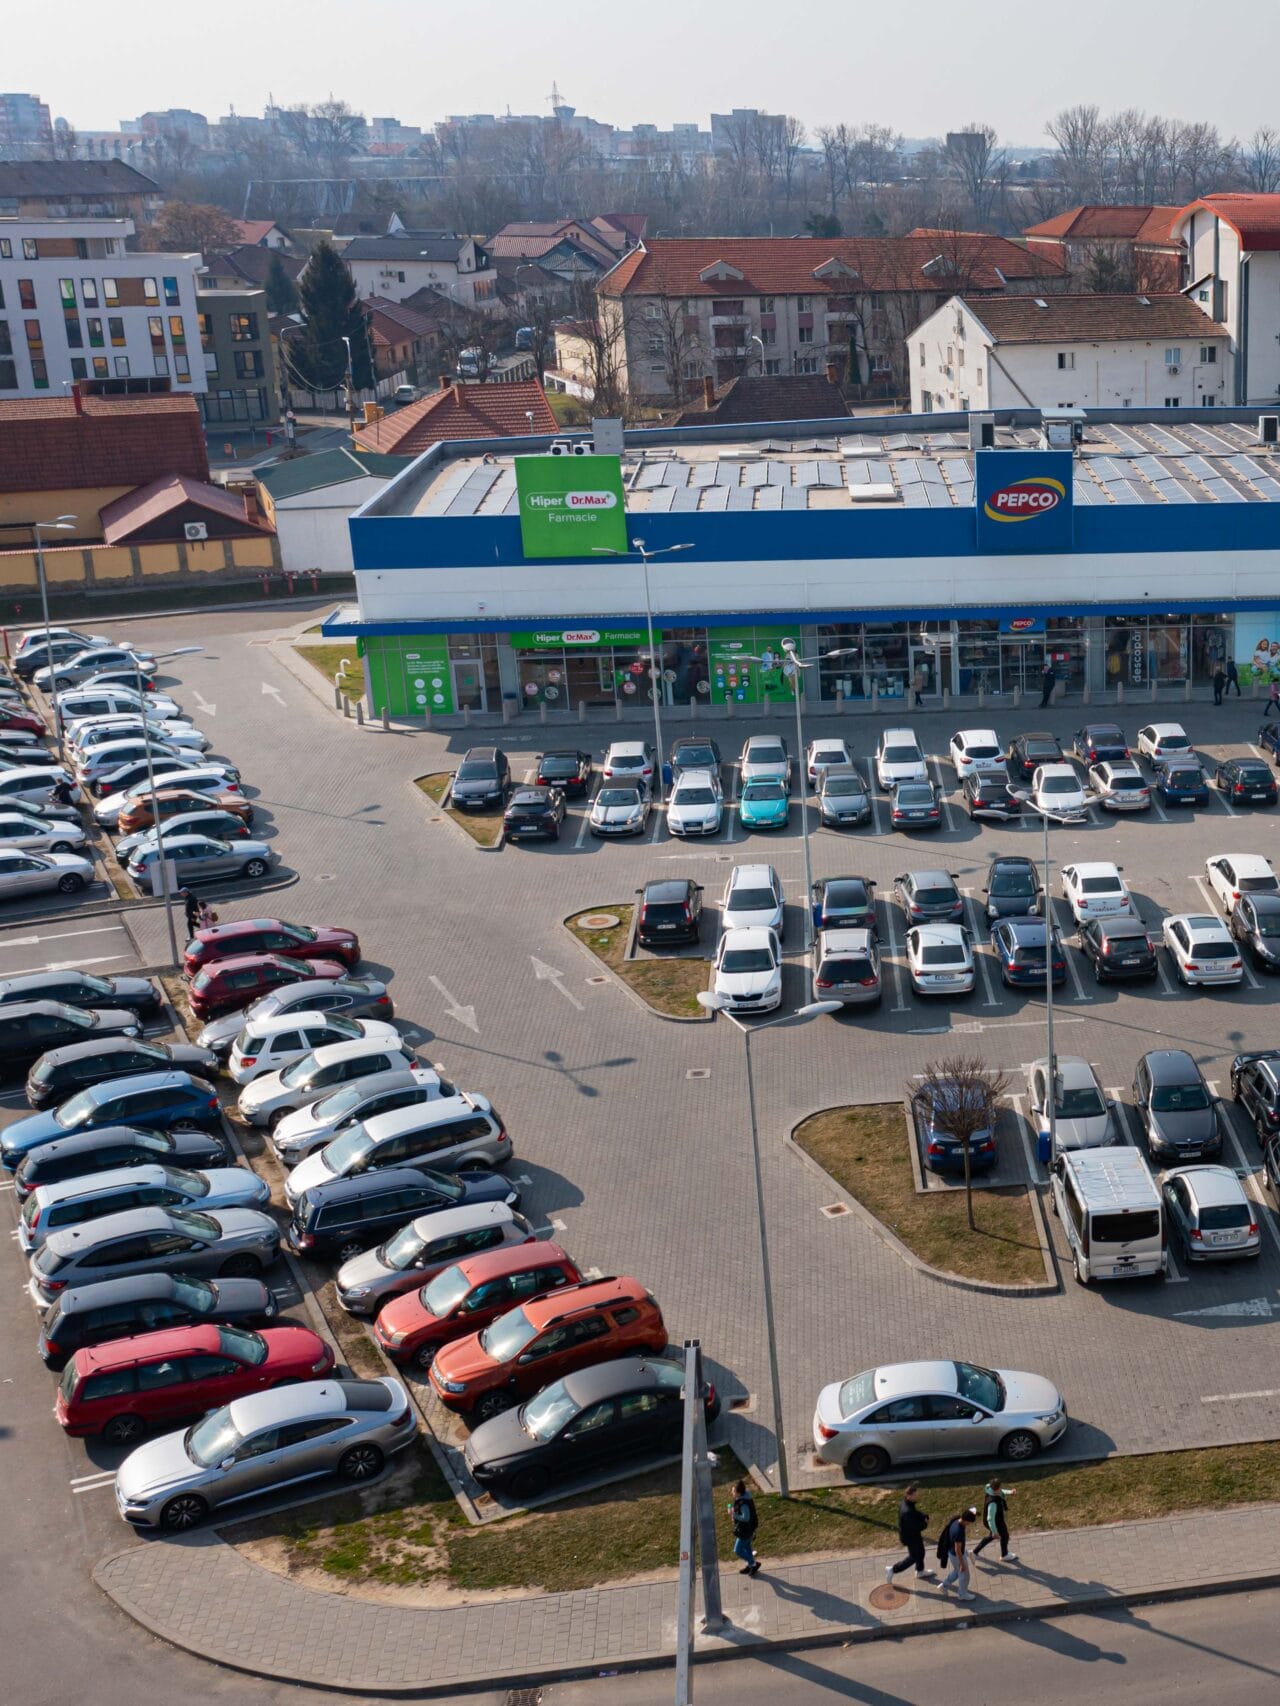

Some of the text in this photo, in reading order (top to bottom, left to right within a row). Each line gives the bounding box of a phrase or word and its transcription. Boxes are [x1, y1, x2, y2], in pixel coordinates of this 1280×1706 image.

[530, 495, 563, 508] Hiper
[996, 492, 1053, 508] PEPCO
[548, 512, 597, 523] Farmacie
[536, 634, 561, 643] Hiper
[605, 632, 641, 640] Farmacie
